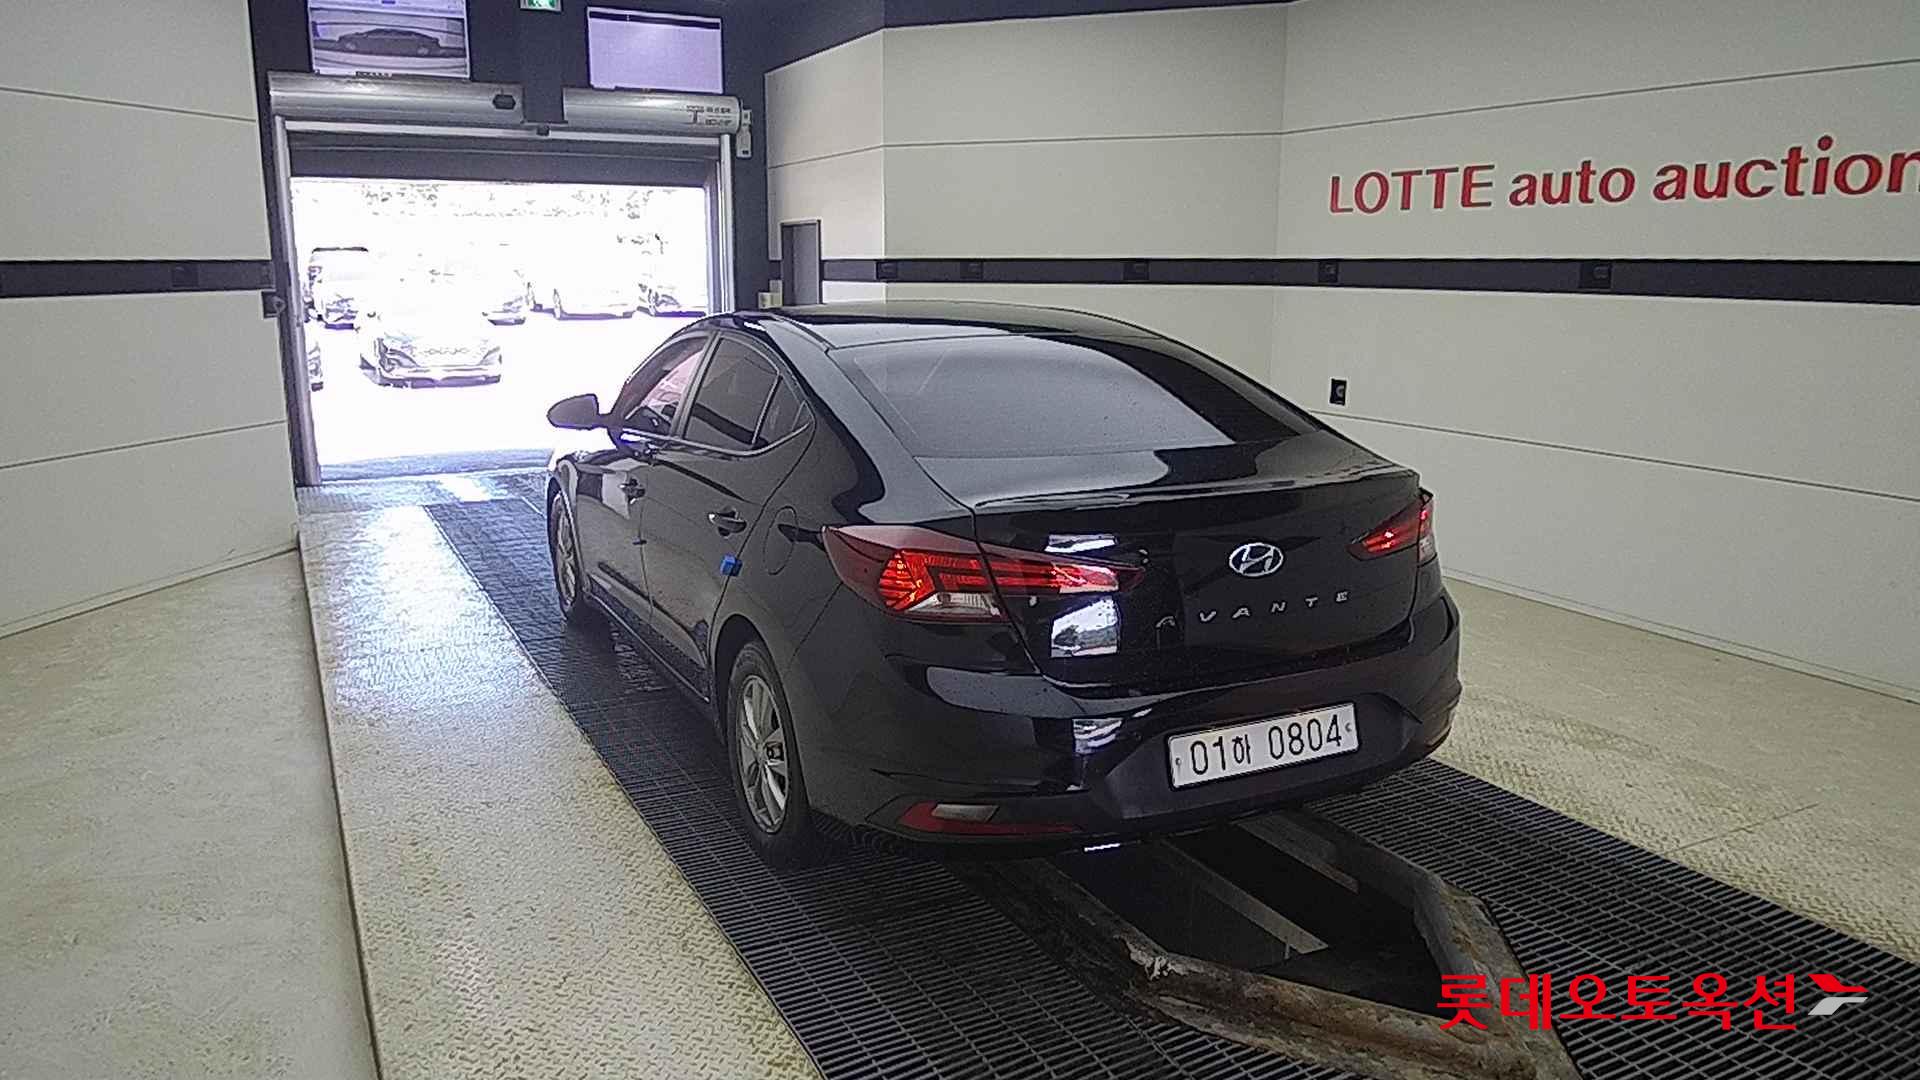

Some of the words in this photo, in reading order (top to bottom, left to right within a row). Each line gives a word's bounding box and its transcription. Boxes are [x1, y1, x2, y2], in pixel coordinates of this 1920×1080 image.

[1330, 164, 1495, 213] LOTTE
[1509, 160, 1636, 205] auto
[1156, 592, 1348, 628] AVANTE
[1190, 734, 1251, 775] 01하
[1268, 714, 1342, 760] 0804
